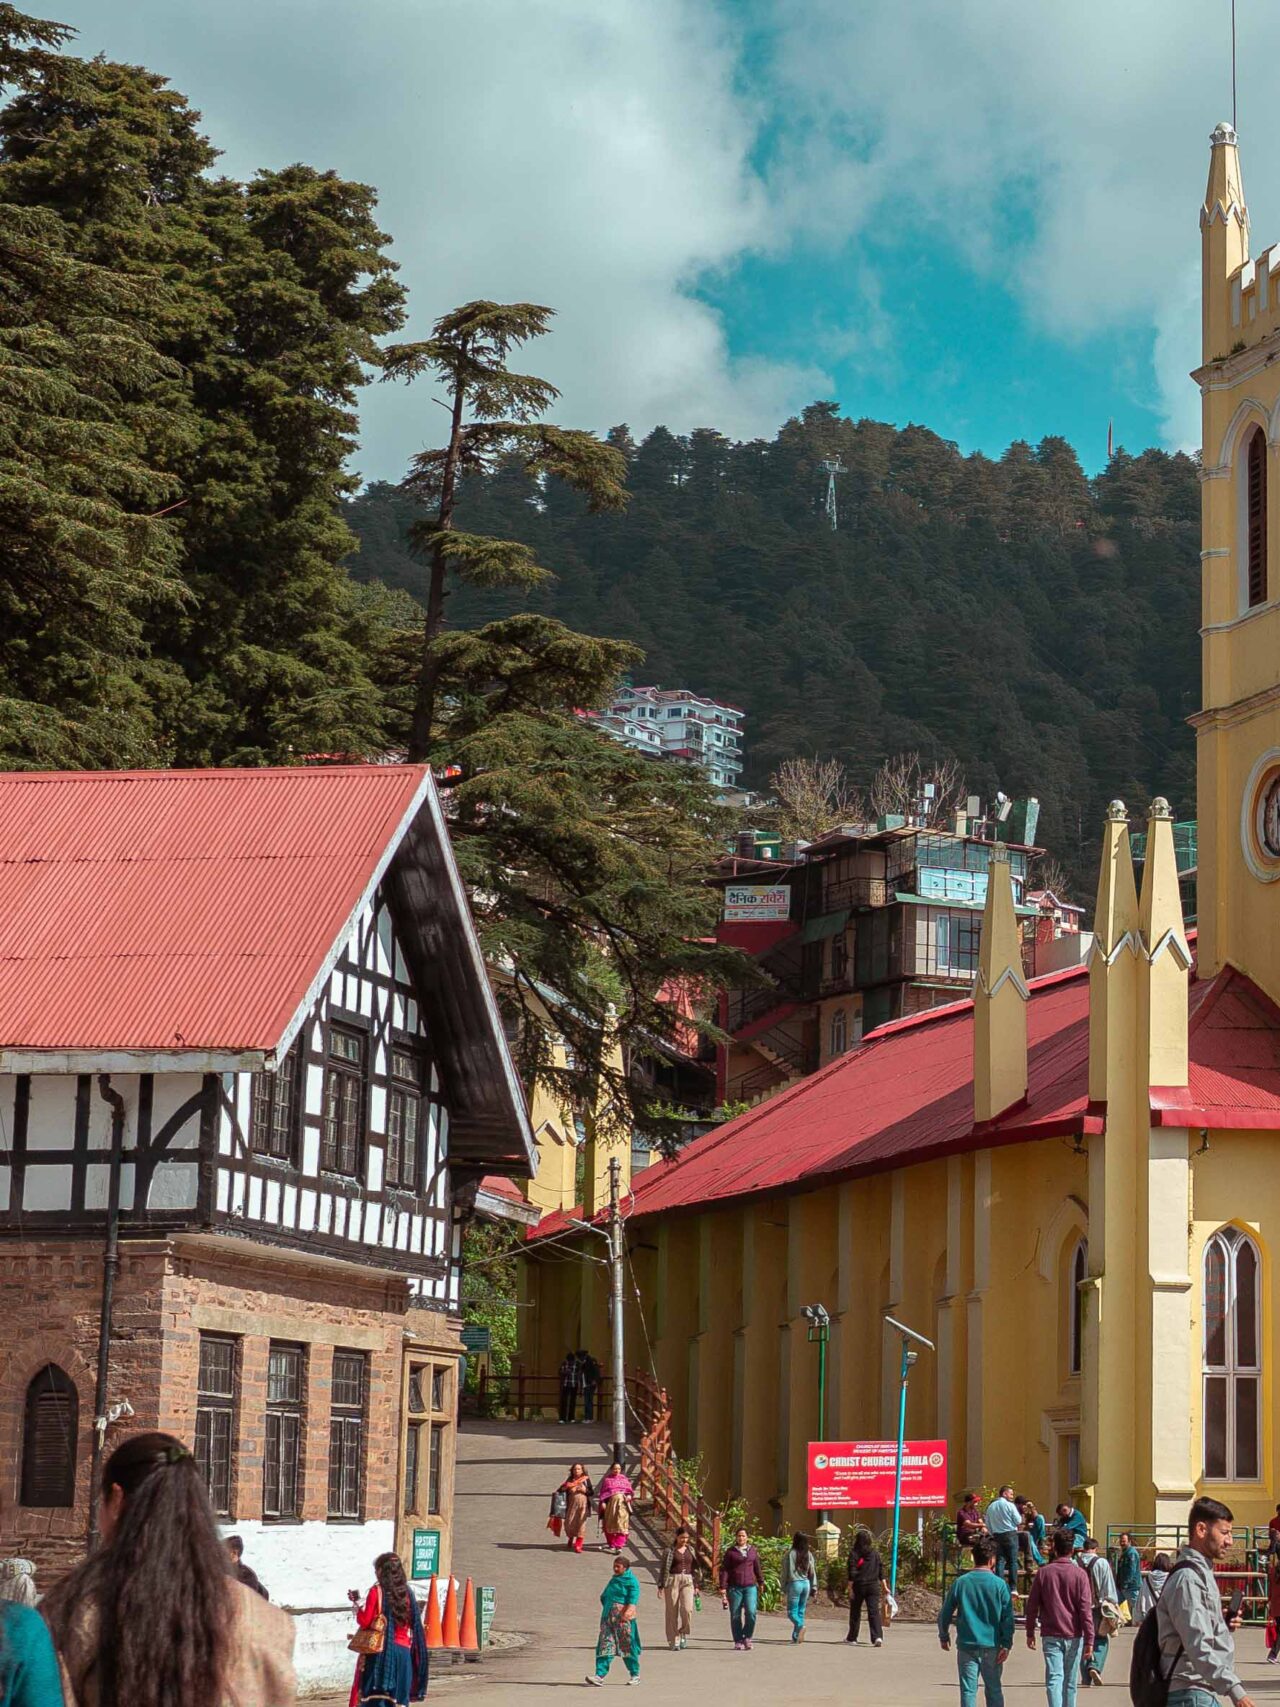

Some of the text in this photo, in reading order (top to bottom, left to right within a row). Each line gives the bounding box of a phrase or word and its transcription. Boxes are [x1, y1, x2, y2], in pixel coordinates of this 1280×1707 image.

[829, 1456, 928, 1467] CHRIST CHURCH HIMLA
